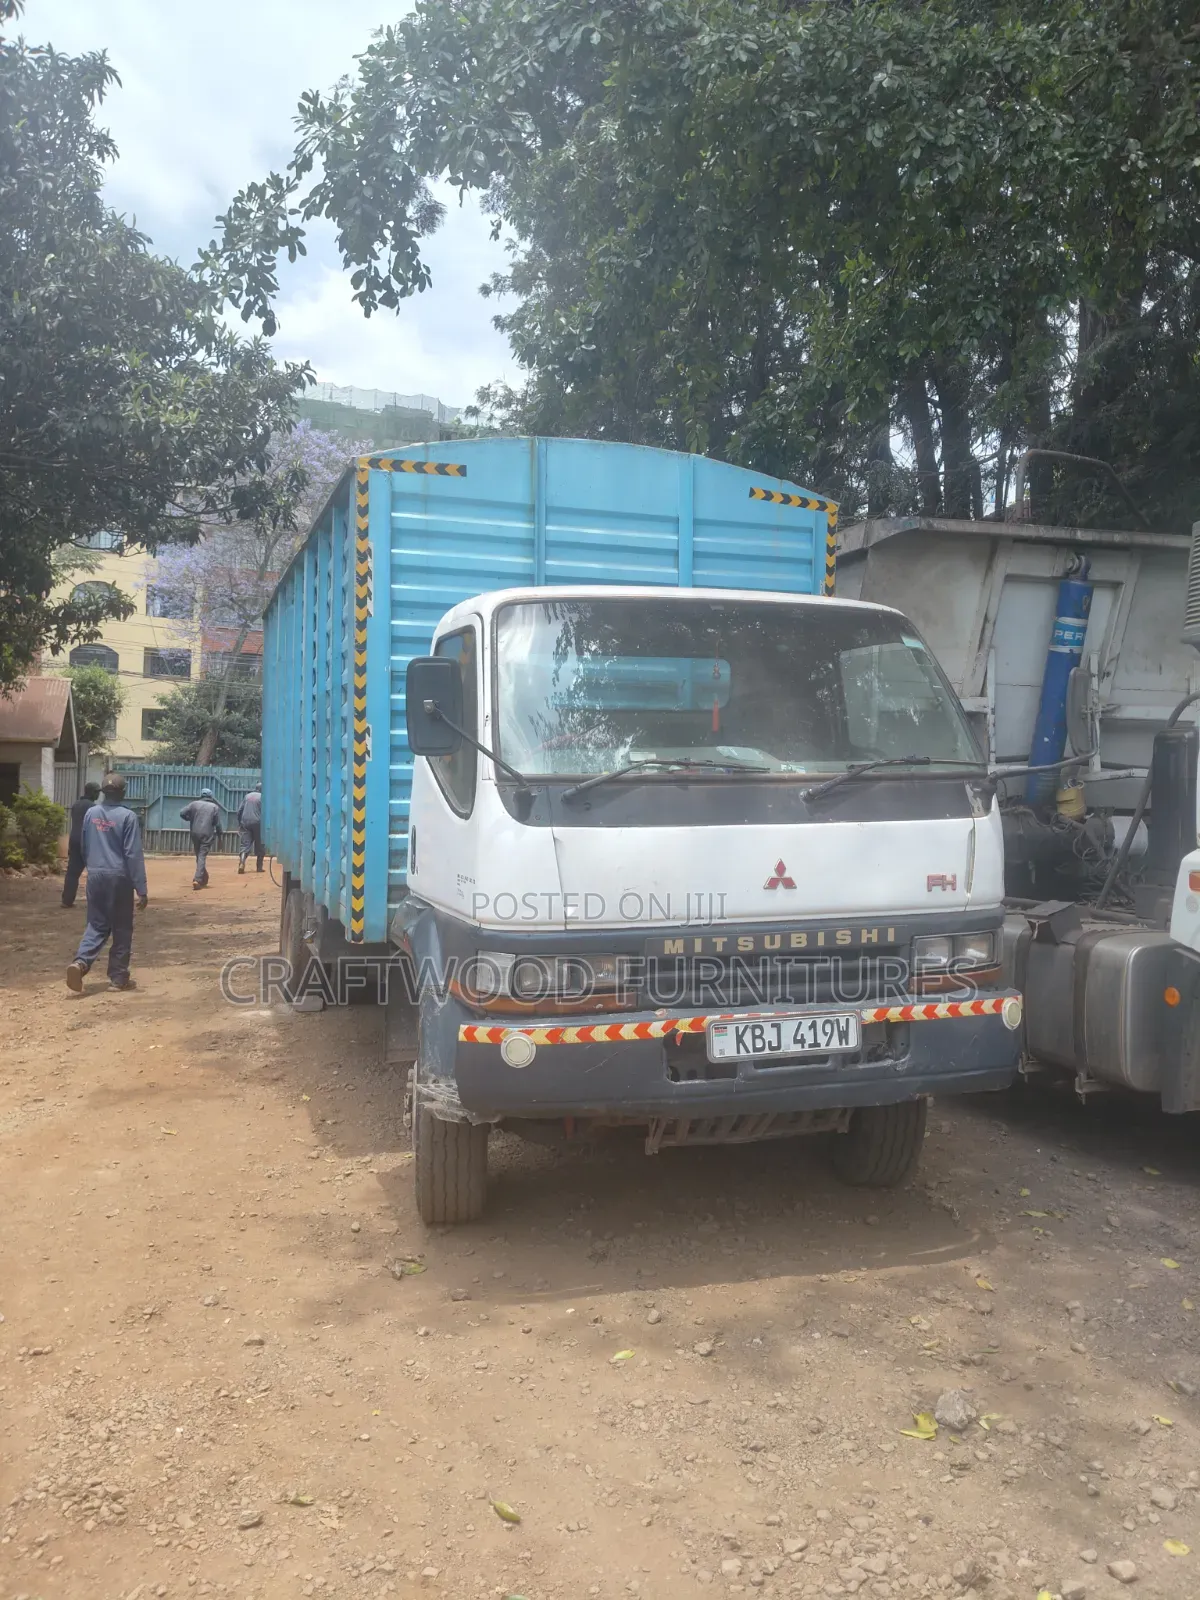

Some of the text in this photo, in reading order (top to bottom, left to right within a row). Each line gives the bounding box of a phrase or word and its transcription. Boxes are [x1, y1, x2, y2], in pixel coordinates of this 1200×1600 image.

[927, 873, 957, 892] FH
[664, 927, 895, 955] MITSUBISHI
[735, 1017, 850, 1054] KBJ 419W
